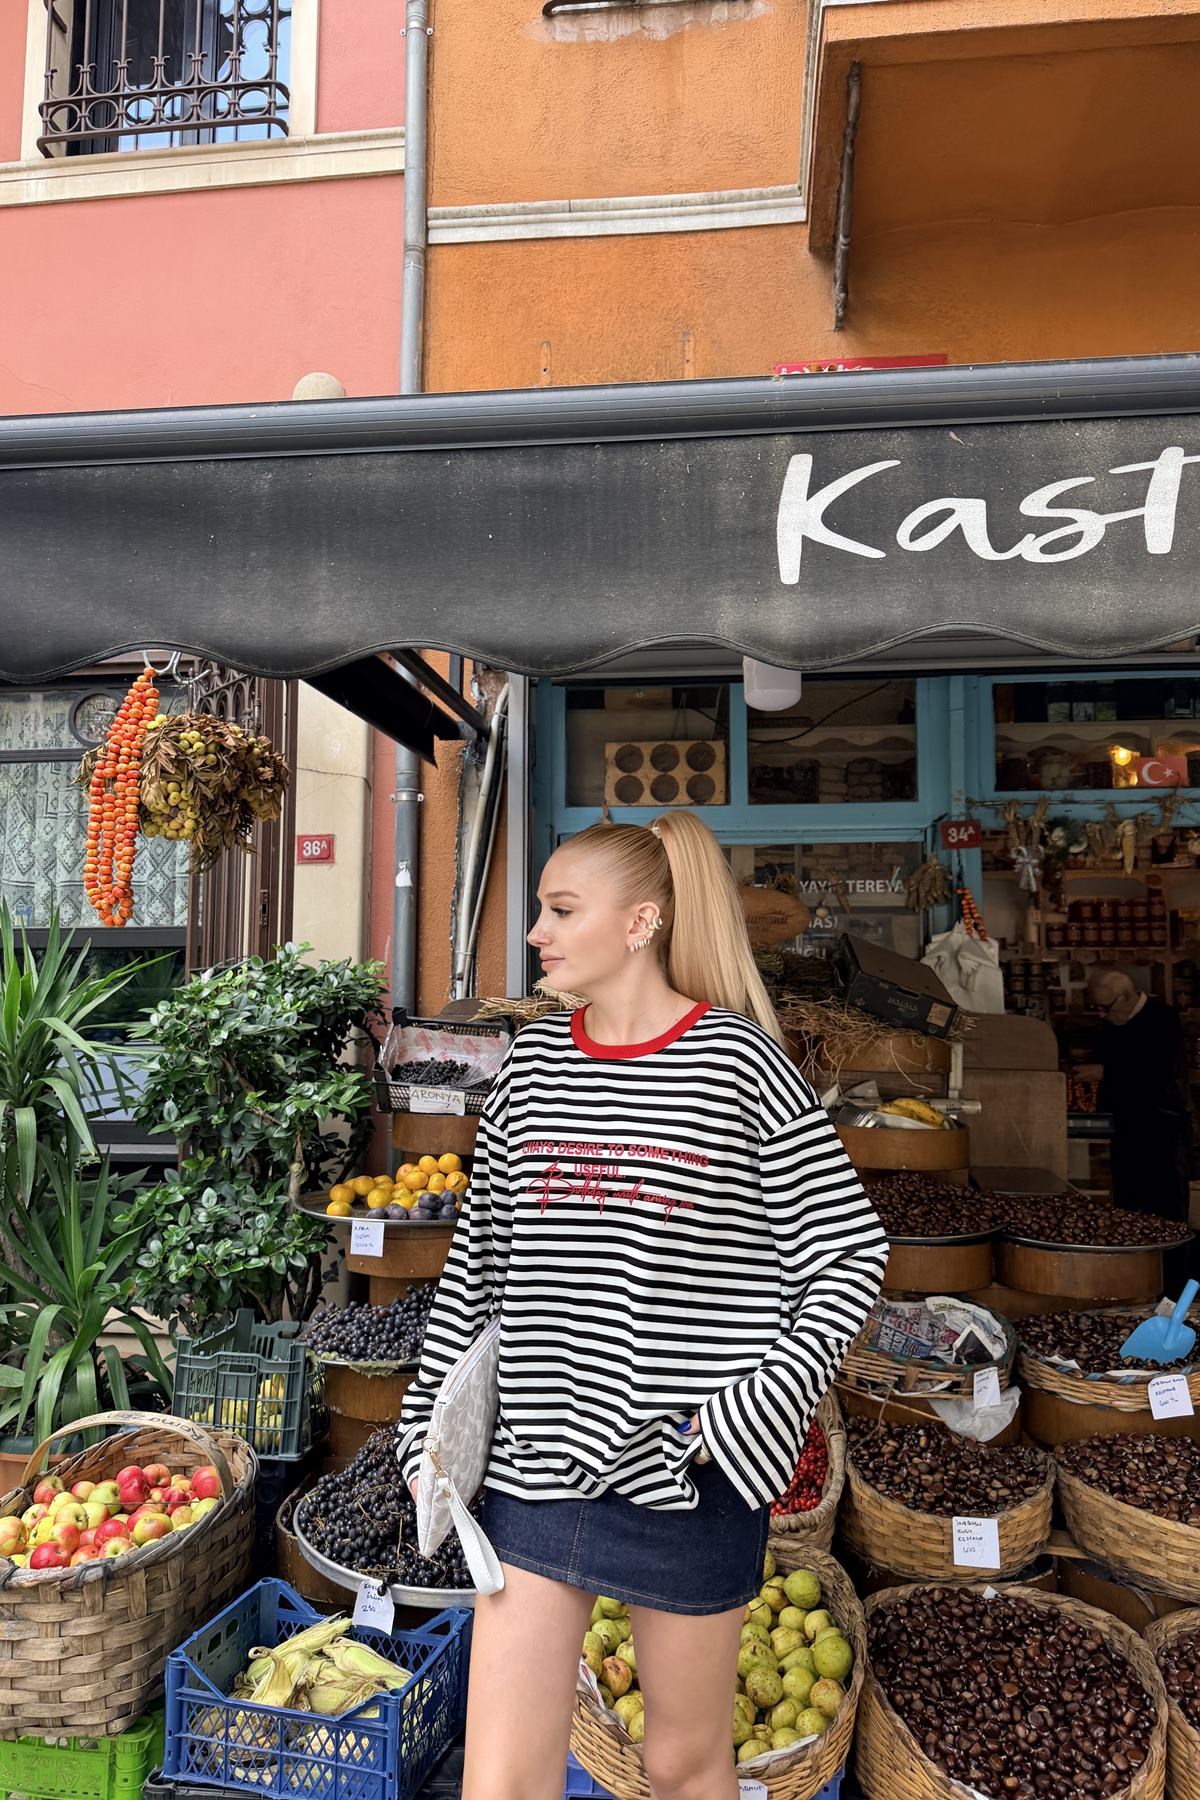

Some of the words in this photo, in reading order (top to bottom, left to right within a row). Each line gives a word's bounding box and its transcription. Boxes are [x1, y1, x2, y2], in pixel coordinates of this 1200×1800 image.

[303, 840, 328, 857] 36A
[410, 1089, 462, 1105] ARONYA
[557, 1142, 604, 1156] DESIRE
[607, 1143, 625, 1157] TO
[627, 1144, 710, 1168] SOMETHING
